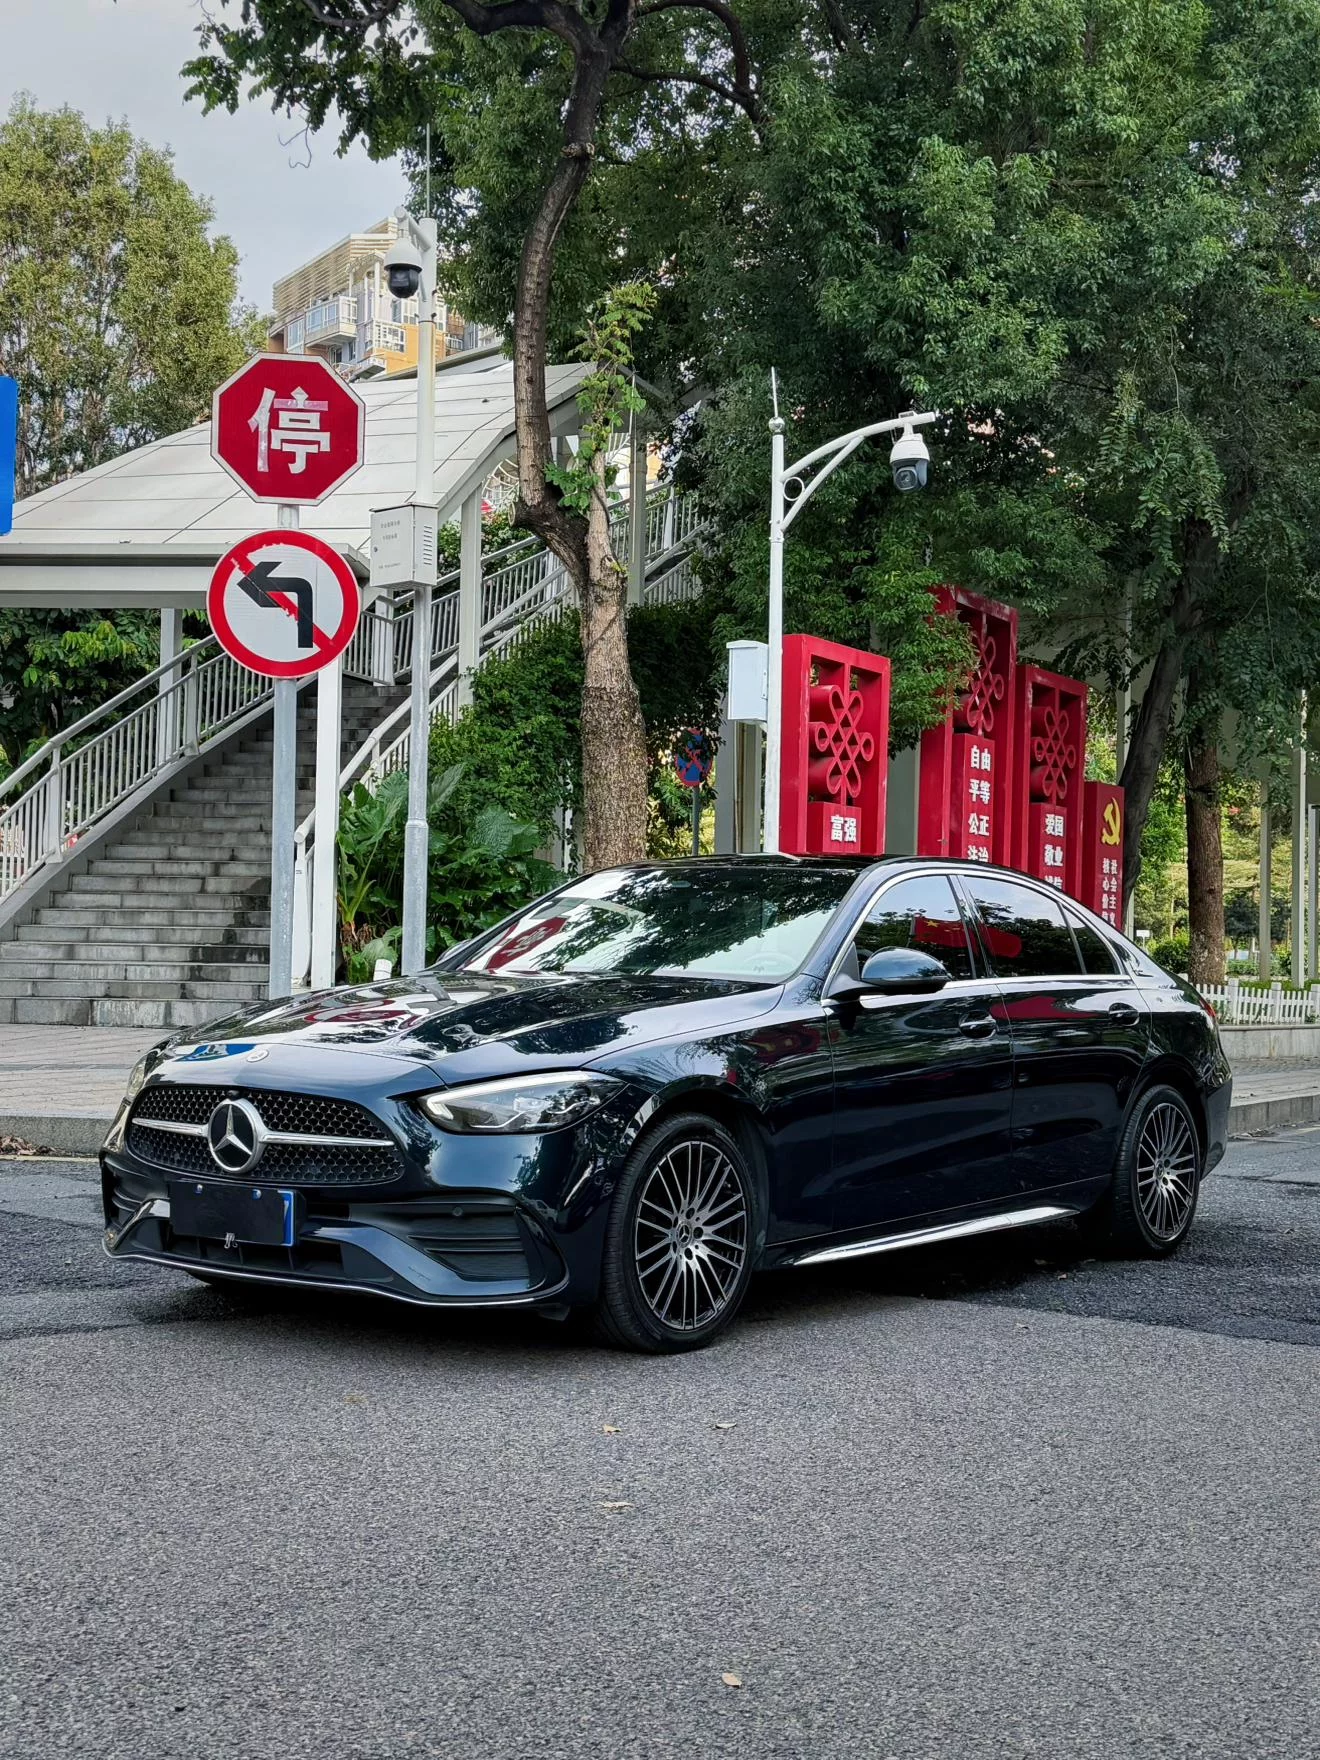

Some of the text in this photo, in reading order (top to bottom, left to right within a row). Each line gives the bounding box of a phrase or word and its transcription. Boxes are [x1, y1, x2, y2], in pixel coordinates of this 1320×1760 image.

[248, 386, 330, 474] 停
[970, 745, 991, 772] 自由
[968, 778, 991, 805] 平等
[831, 814, 857, 843] 富强
[968, 812, 990, 837] 公正
[1045, 813, 1064, 837] 爱国
[1044, 843, 1064, 867] 敬业
